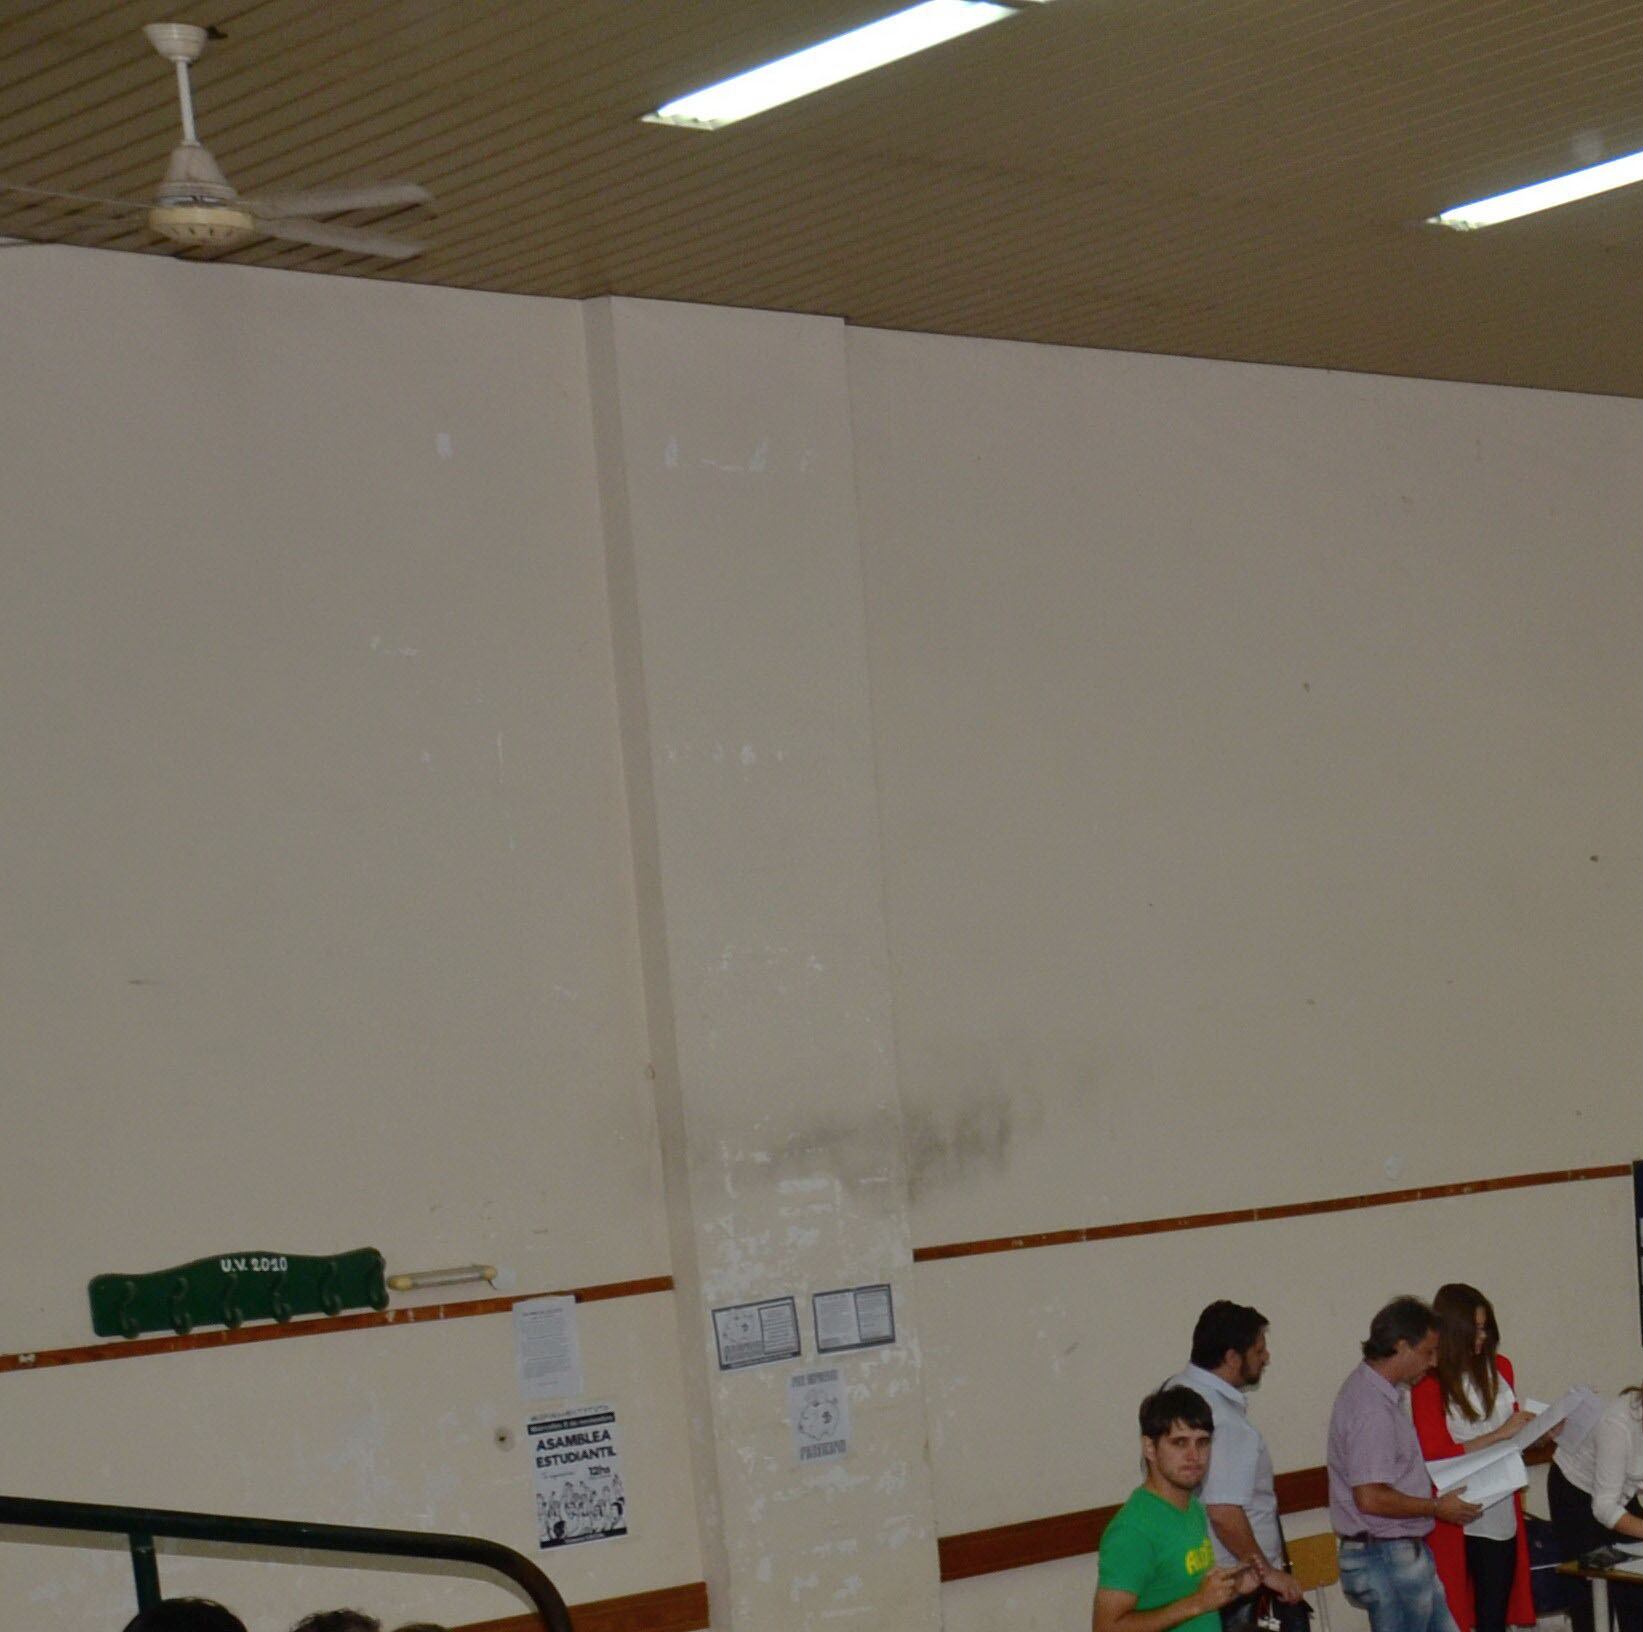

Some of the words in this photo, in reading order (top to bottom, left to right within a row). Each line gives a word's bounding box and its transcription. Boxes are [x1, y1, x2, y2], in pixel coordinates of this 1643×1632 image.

[250, 1256, 288, 1272] 2010
[537, 1429, 611, 1451] ASAMBLEA
[536, 1446, 616, 1468] ESTUDIANTIL
